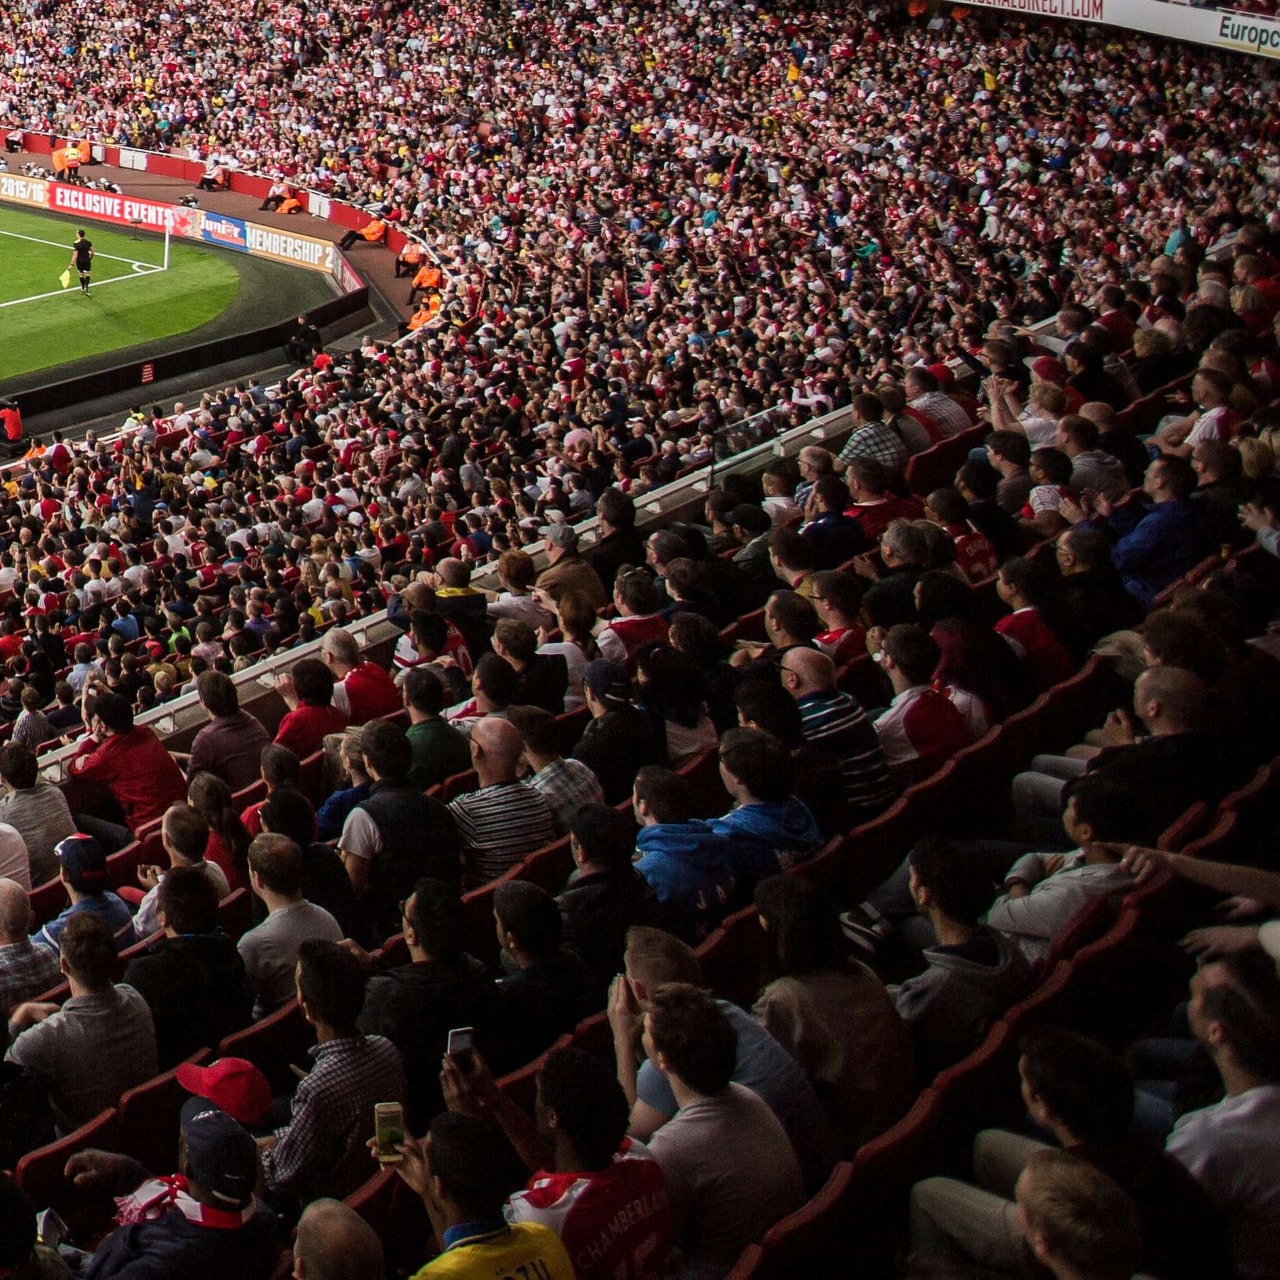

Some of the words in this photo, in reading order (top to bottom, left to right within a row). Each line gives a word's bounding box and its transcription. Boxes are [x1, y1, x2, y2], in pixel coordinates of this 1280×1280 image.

[1, 177, 45, 204] 2015/16
[55, 187, 121, 218] EXCLUSIVE
[123, 202, 175, 226] EVENTS
[247, 223, 322, 264] MEMBERSHIP
